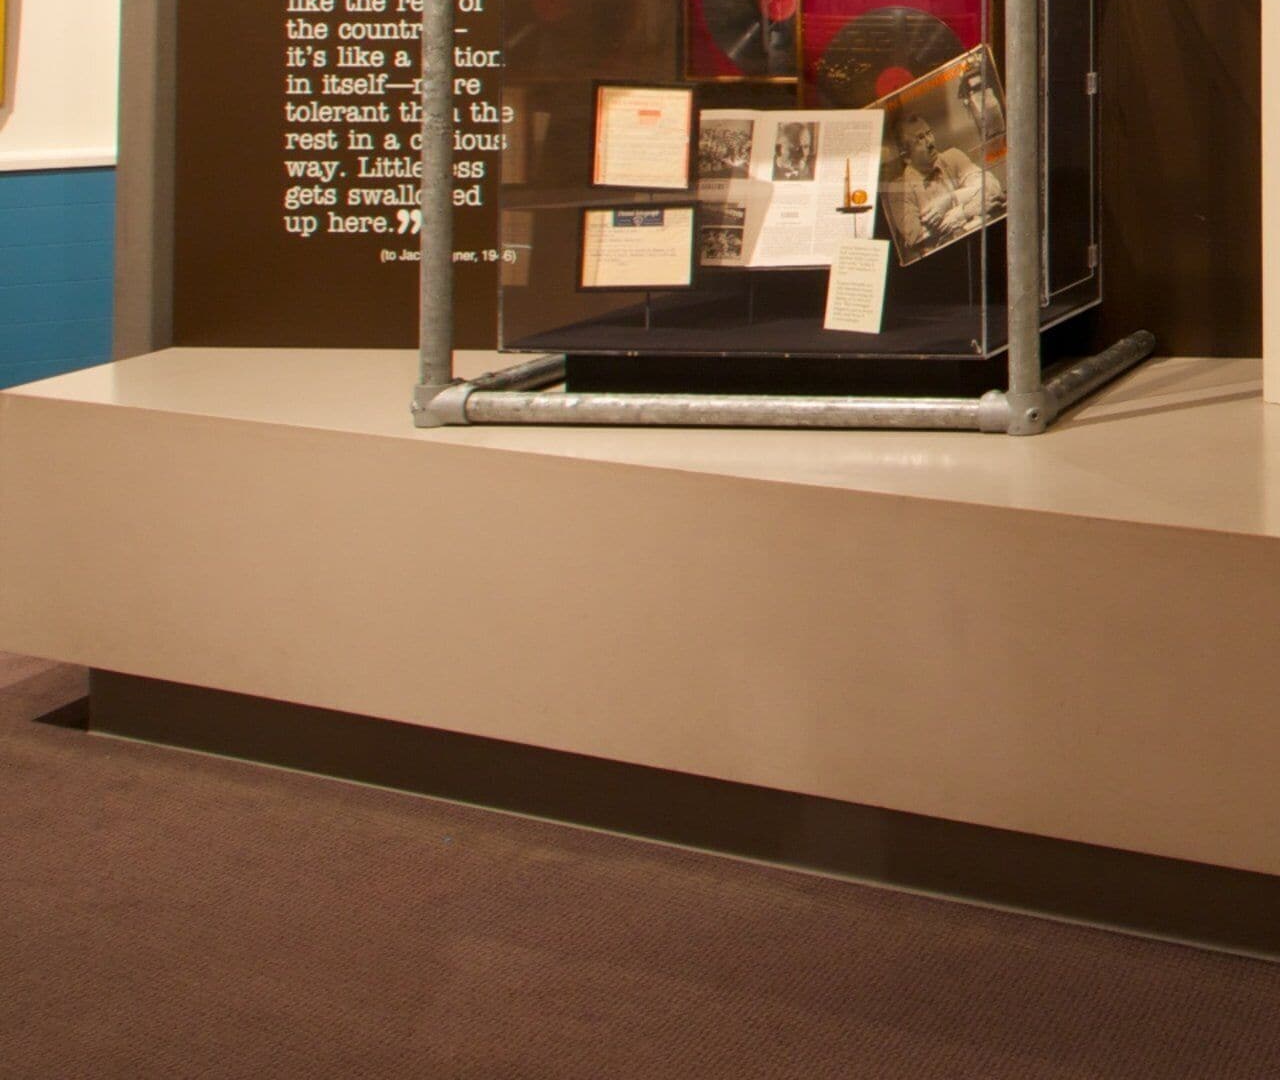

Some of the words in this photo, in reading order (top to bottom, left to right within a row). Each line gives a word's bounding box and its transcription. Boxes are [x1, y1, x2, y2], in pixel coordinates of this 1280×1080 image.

[286, 18, 328, 39] the
[286, 46, 326, 67] it’s
[337, 46, 384, 67] like
[395, 50, 411, 67] a
[286, 74, 312, 94] in
[285, 101, 390, 122] tolerant
[470, 102, 514, 123] the
[285, 130, 338, 150] rest
[348, 130, 374, 150] in
[384, 133, 400, 150] a
[285, 161, 346, 182] way.
[358, 157, 423, 180] Little
[285, 185, 337, 209] gets
[284, 216, 318, 237] up
